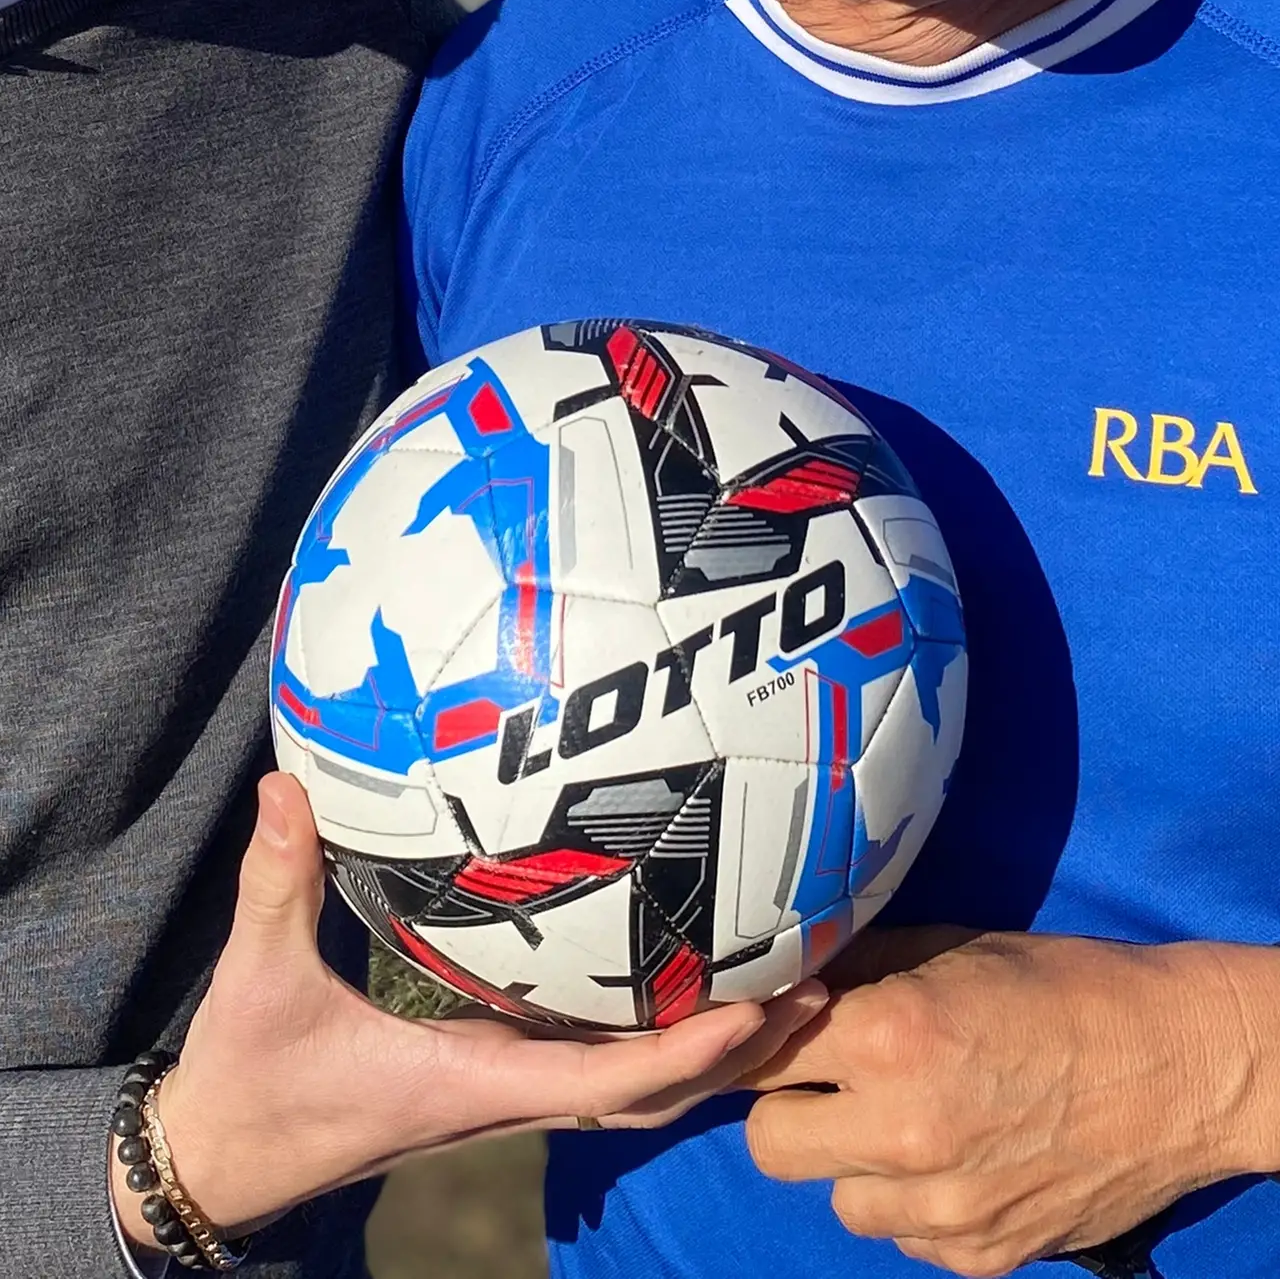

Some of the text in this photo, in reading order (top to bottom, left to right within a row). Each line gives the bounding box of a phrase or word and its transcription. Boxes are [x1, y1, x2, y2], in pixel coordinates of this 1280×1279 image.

[1088, 407, 1259, 494] RBA
[498, 560, 845, 784] LOTTO
[747, 672, 795, 707] FB700
